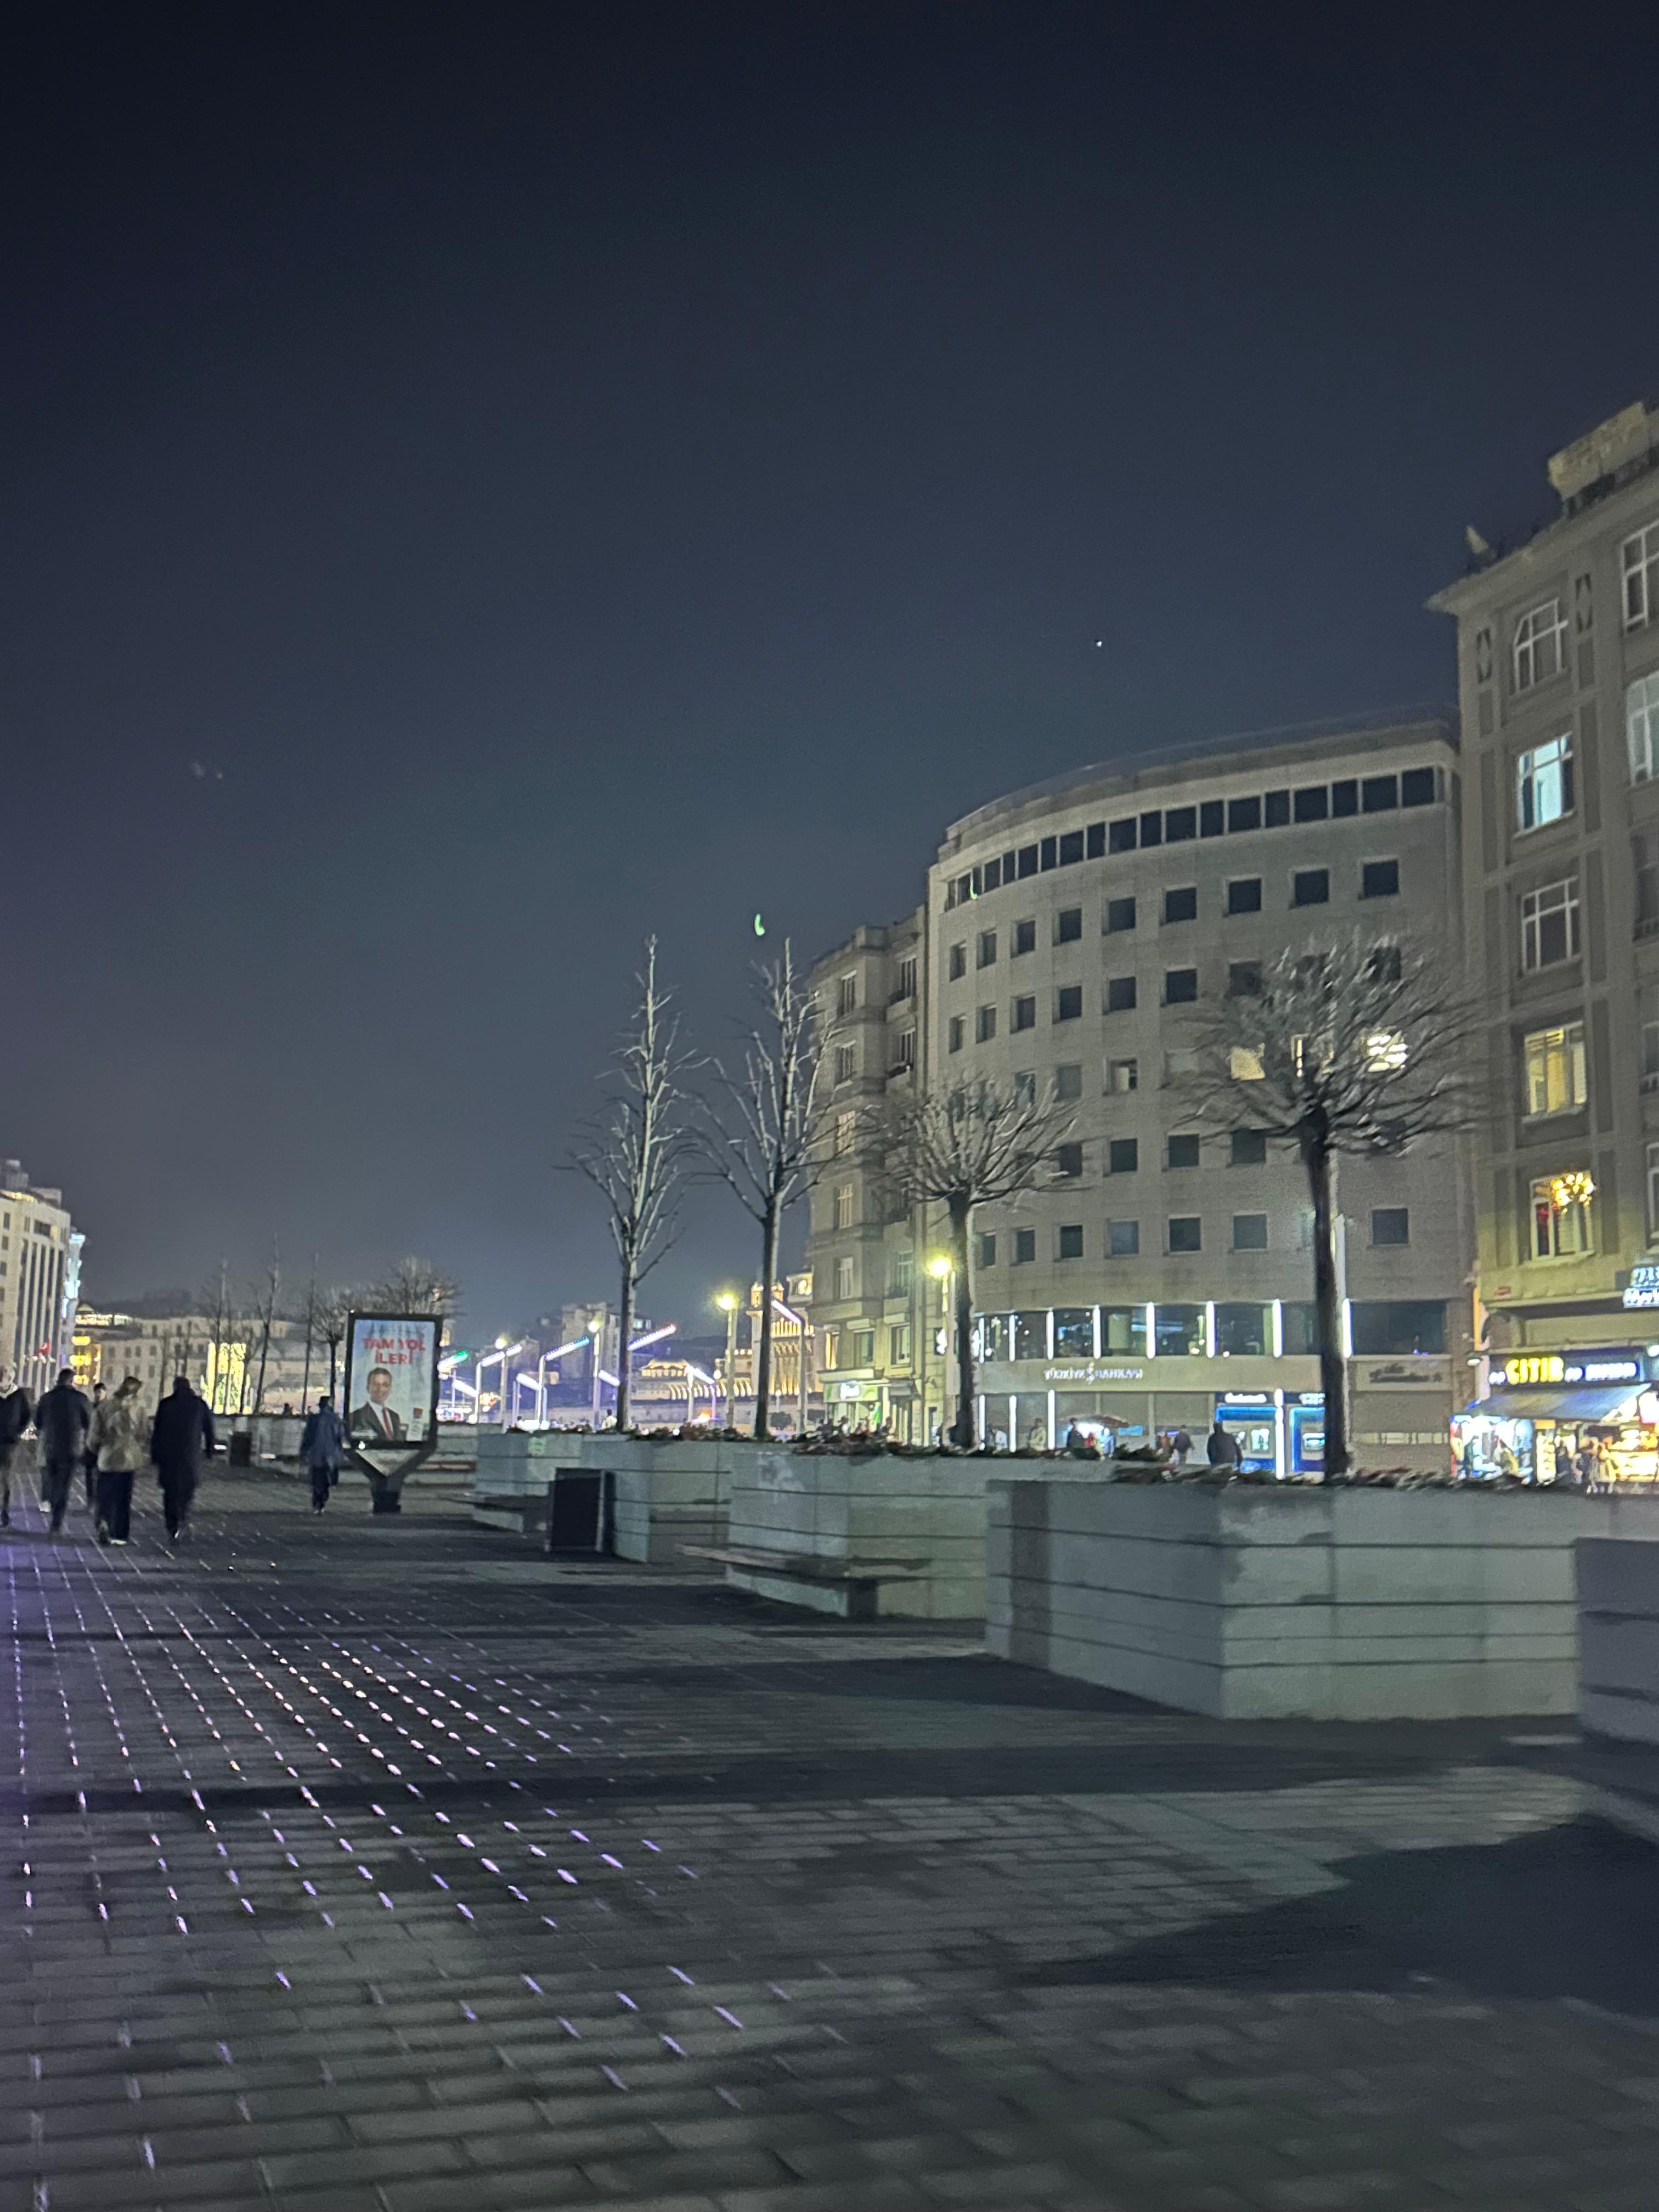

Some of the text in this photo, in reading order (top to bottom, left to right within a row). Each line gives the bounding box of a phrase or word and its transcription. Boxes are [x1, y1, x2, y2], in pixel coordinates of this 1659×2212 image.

[363, 1337, 426, 1351] TAM YOL
[375, 1350, 413, 1364] İLERİ
